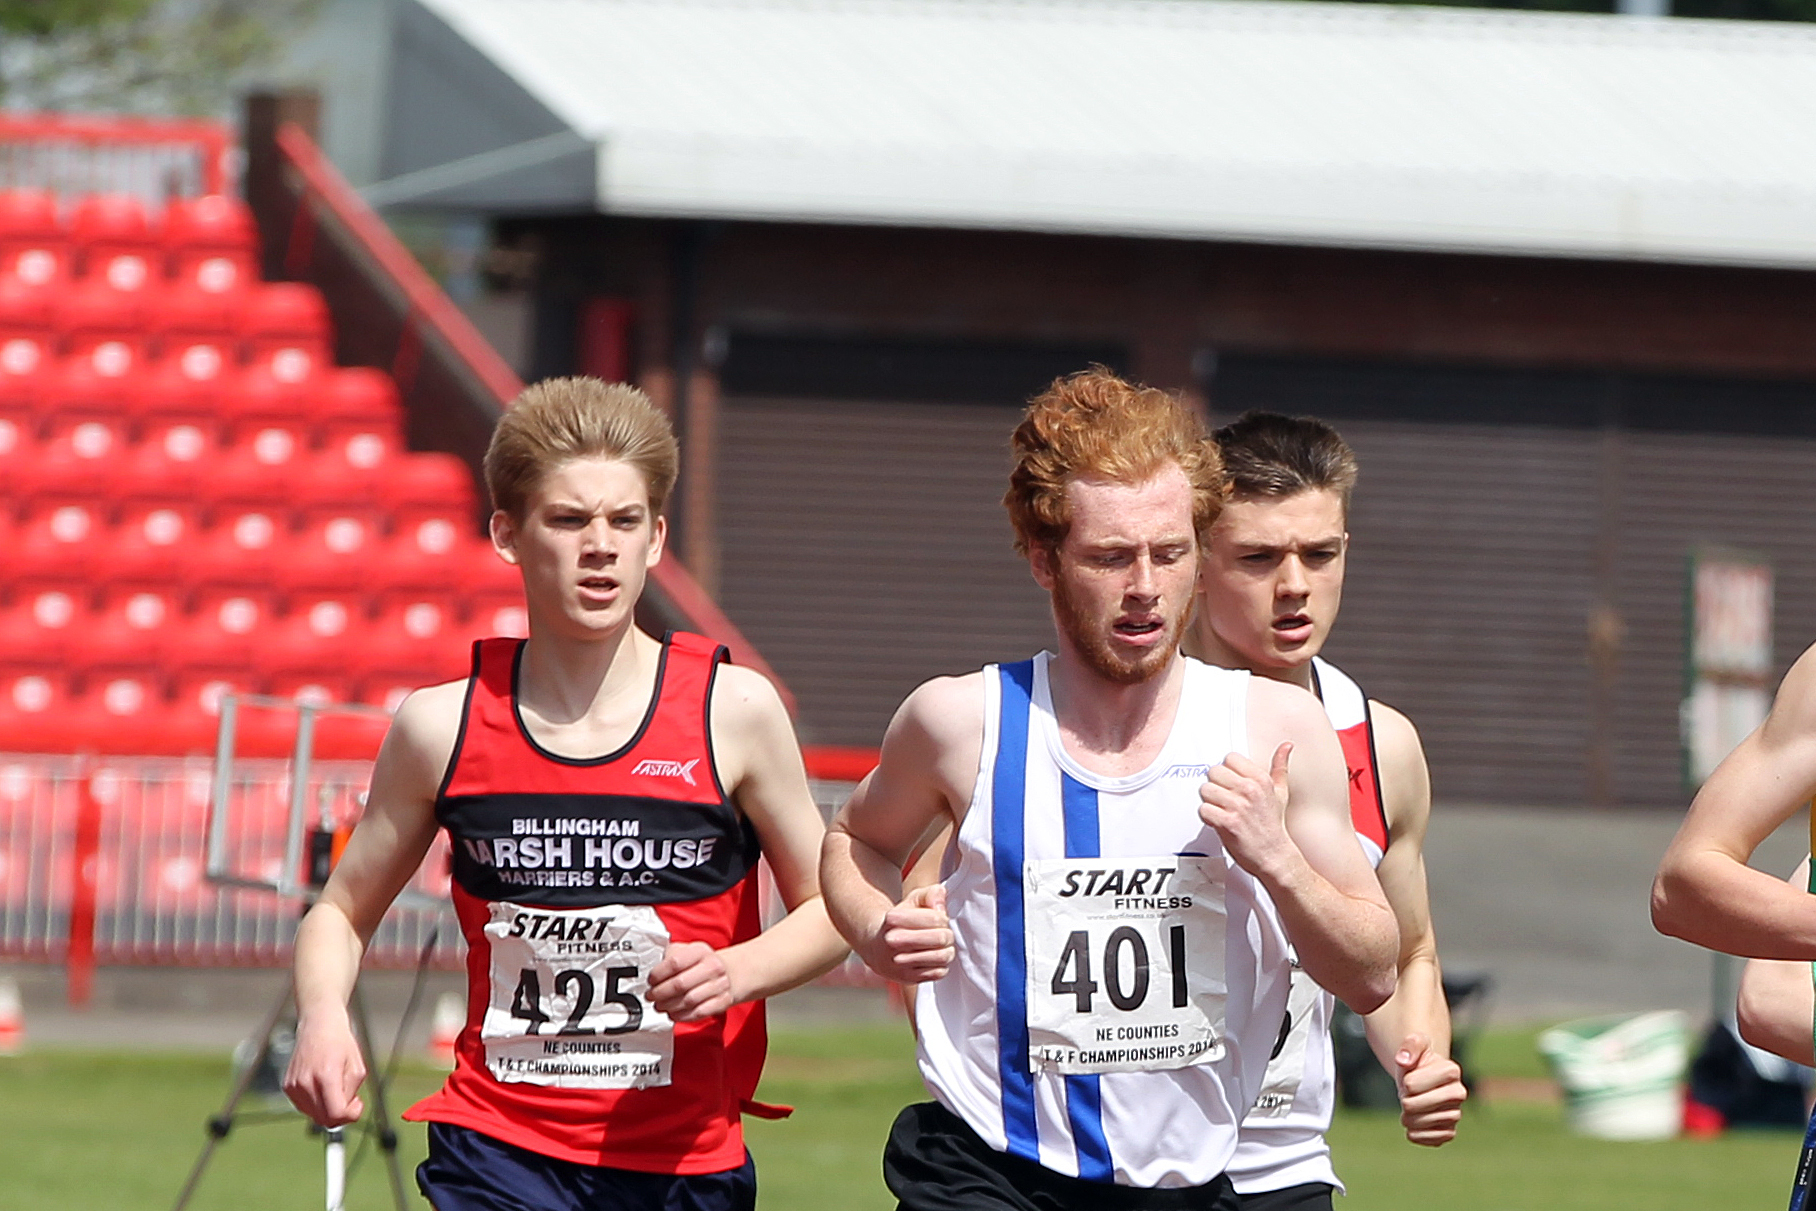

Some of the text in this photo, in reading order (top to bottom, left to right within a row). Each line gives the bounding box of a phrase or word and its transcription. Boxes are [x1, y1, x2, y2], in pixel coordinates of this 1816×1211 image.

[631, 758, 700, 786] FASTRAX
[1161, 762, 1213, 779] FASTRA
[512, 818, 640, 837] BILLINGHAM
[584, 837, 718, 870] HOUSE
[498, 870, 660, 888] HARRIERS & A.C.
[1058, 868, 1177, 898] START
[1114, 897, 1193, 910] FITNESS
[508, 912, 616, 942] START
[557, 940, 633, 955] FITNESS
[1051, 925, 1188, 1014] 401
[511, 966, 644, 1037] 425
[1096, 1024, 1179, 1041] NE COUNTIES
[544, 1041, 621, 1055] NE COUNTIES
[1055, 1050, 1064, 1063] &
[1068, 1050, 1076, 1063] F
[1079, 1046, 1185, 1064] CHAMPIONSHIPS
[517, 1060, 525, 1073] F
[527, 1061, 629, 1077] CHAMPIONSHIPS
[631, 1062, 661, 1077] 2014
